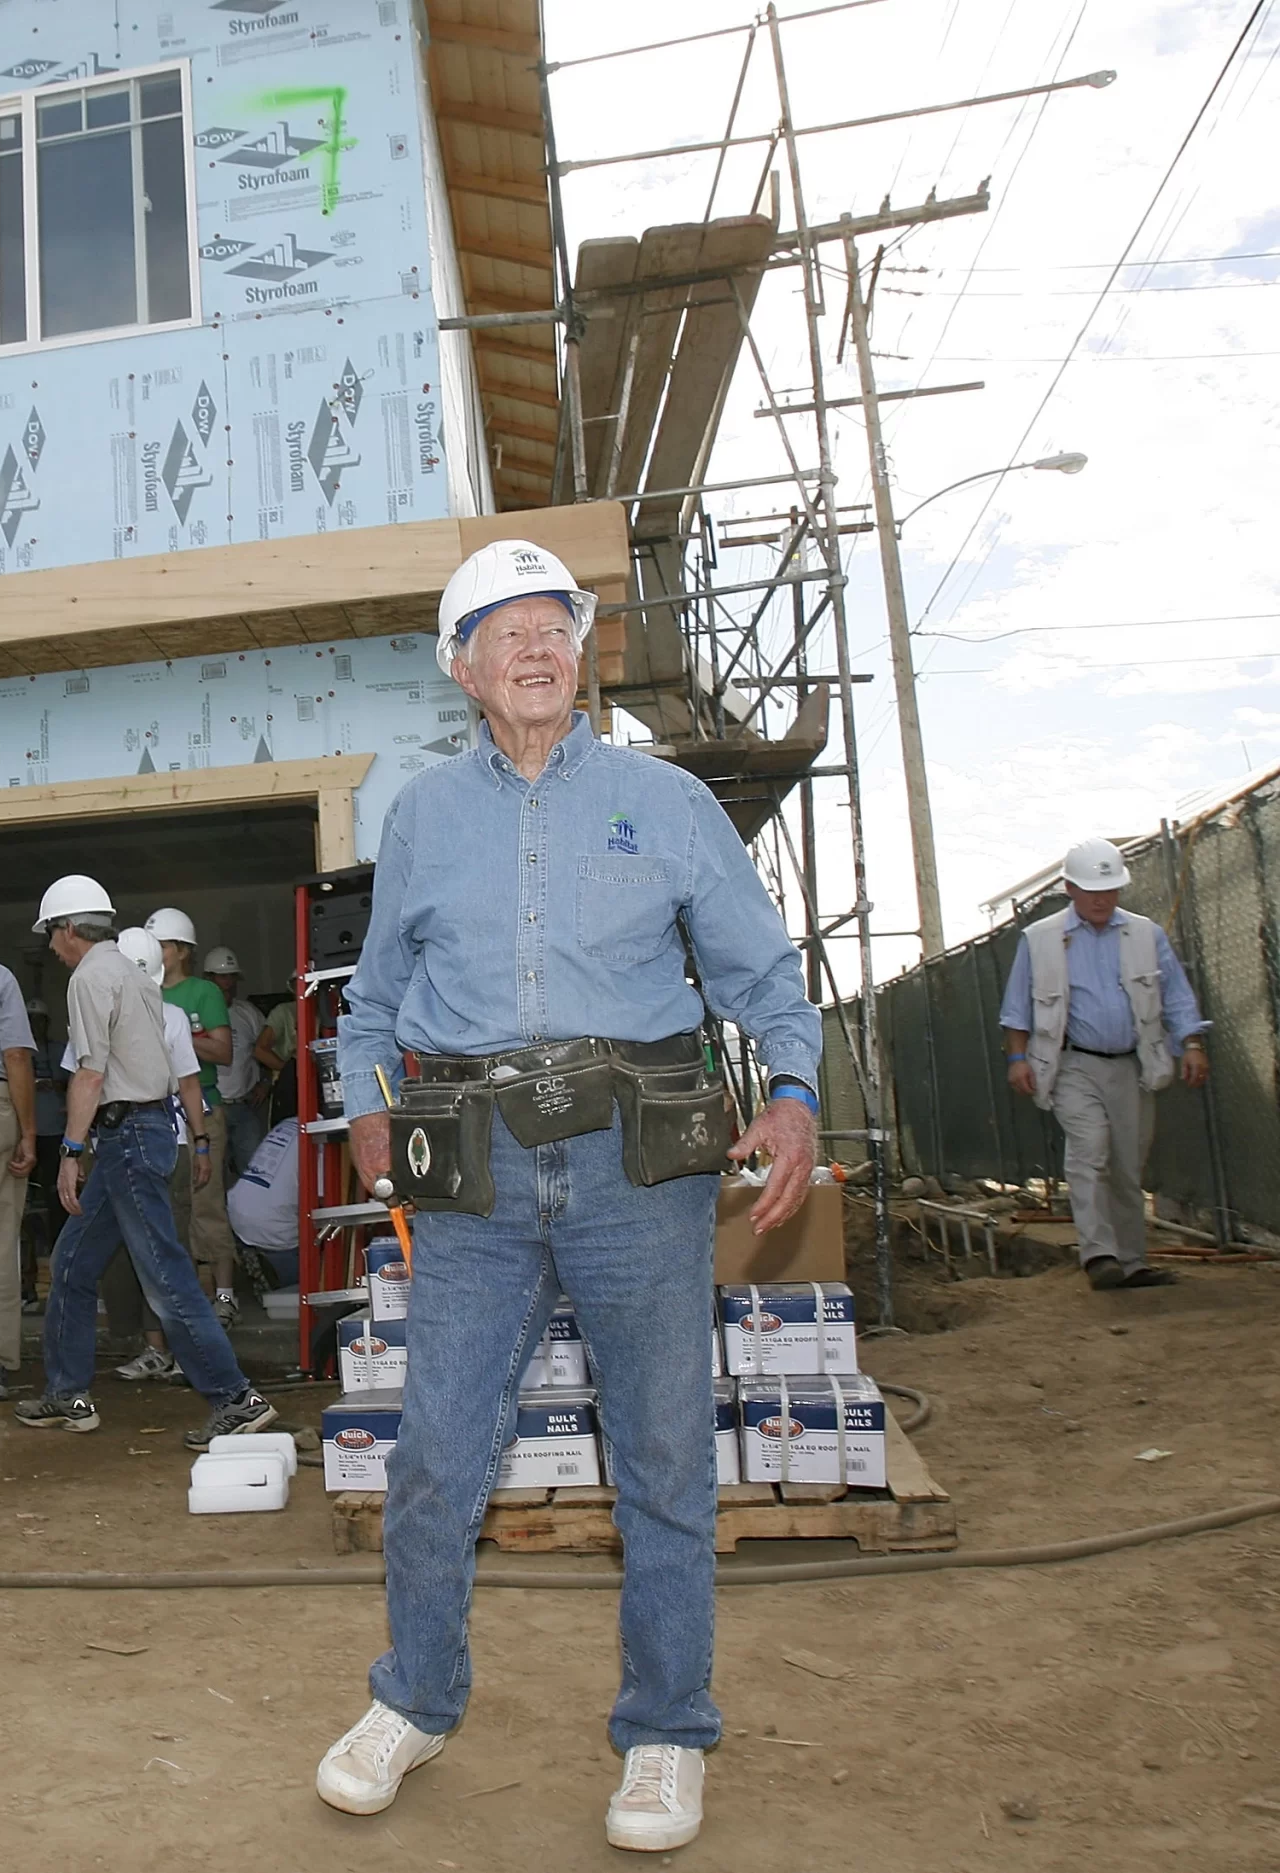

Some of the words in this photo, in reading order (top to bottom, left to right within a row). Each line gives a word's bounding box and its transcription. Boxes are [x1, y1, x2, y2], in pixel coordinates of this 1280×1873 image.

[229, 12, 299, 36] Styrofoam
[238, 167, 311, 190] Styrofoam
[245, 280, 319, 304] Styrofoam
[417, 401, 435, 475] Styrofoam
[287, 420, 306, 493] Styrofoam
[141, 441, 160, 513] Styrofoam
[516, 563, 547, 573] Habitat
[608, 837, 639, 852] Habitat
[549, 1320, 571, 1330] ULK
[549, 1330, 571, 1338] AILS
[548, 1413, 578, 1424] BULK
[844, 1418, 873, 1428] AILS
[546, 1423, 579, 1434] NAILS
[341, 1430, 369, 1440] Quick
[533, 1450, 565, 1458] ROOFING
